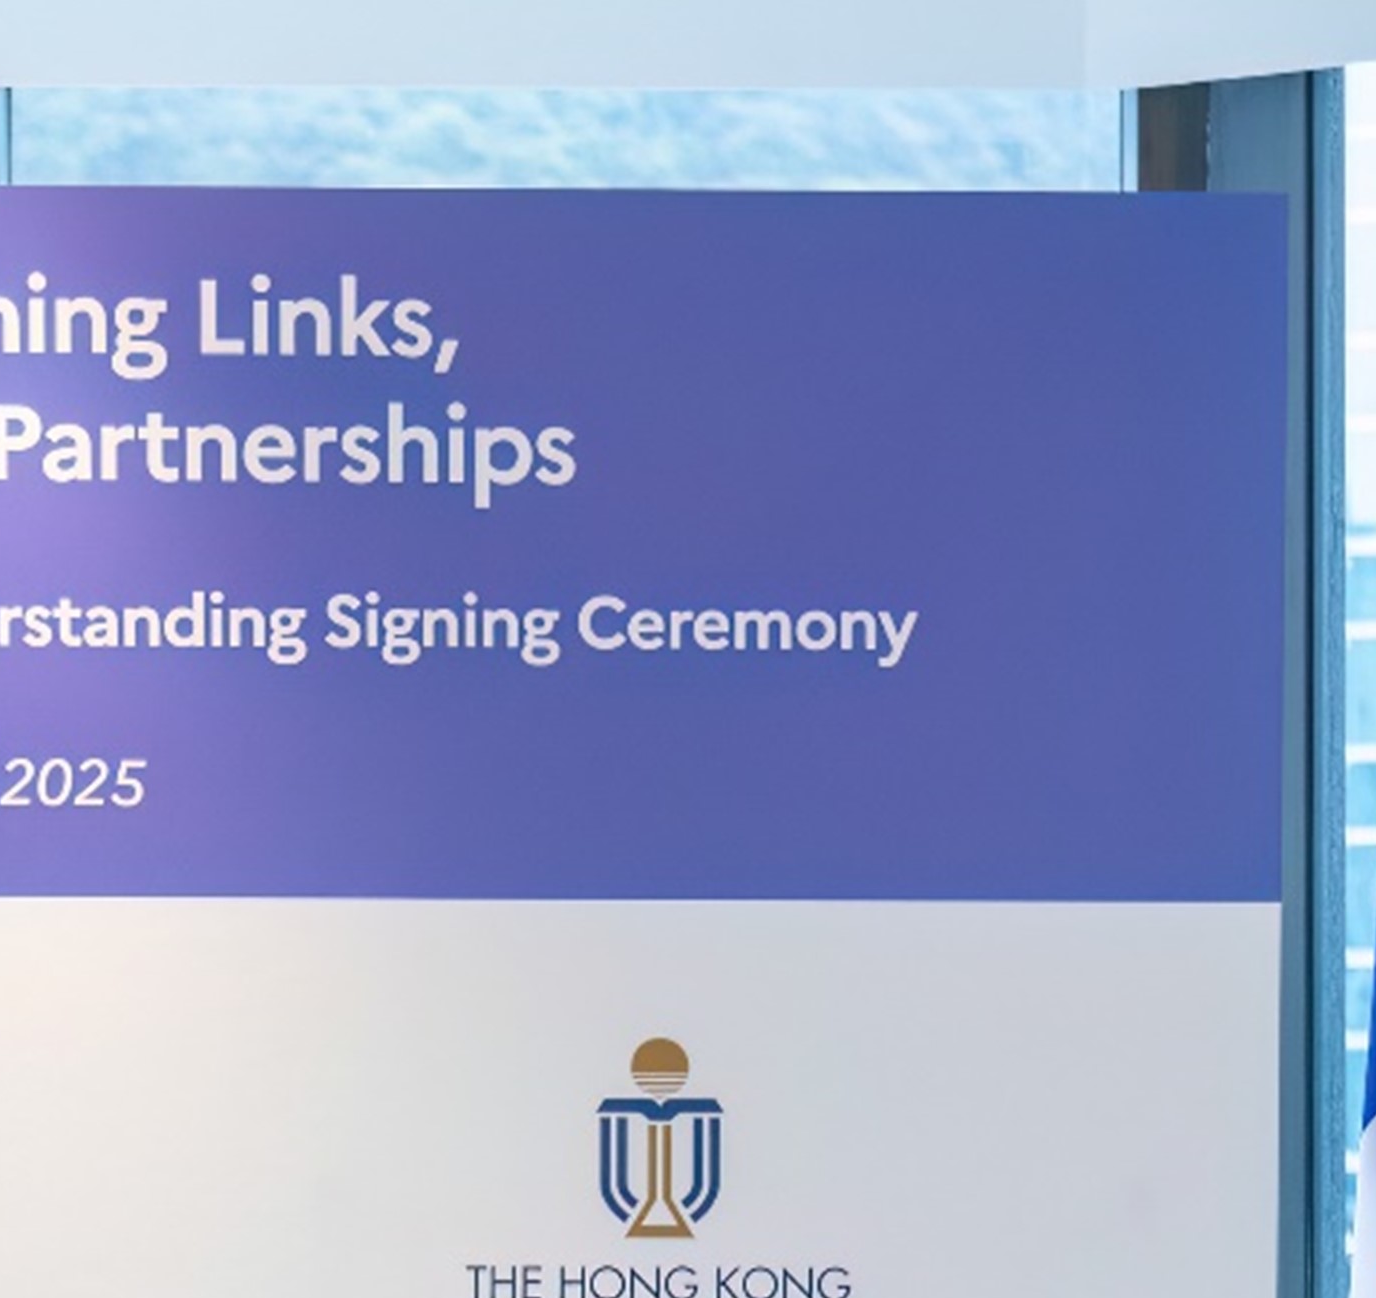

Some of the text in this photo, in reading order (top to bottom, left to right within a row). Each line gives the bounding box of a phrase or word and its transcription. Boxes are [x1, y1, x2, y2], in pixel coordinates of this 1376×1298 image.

[200, 274, 458, 373] Links,
[325, 591, 560, 666] Signing
[579, 595, 918, 667] Ceremony
[0, 758, 147, 806] 2025
